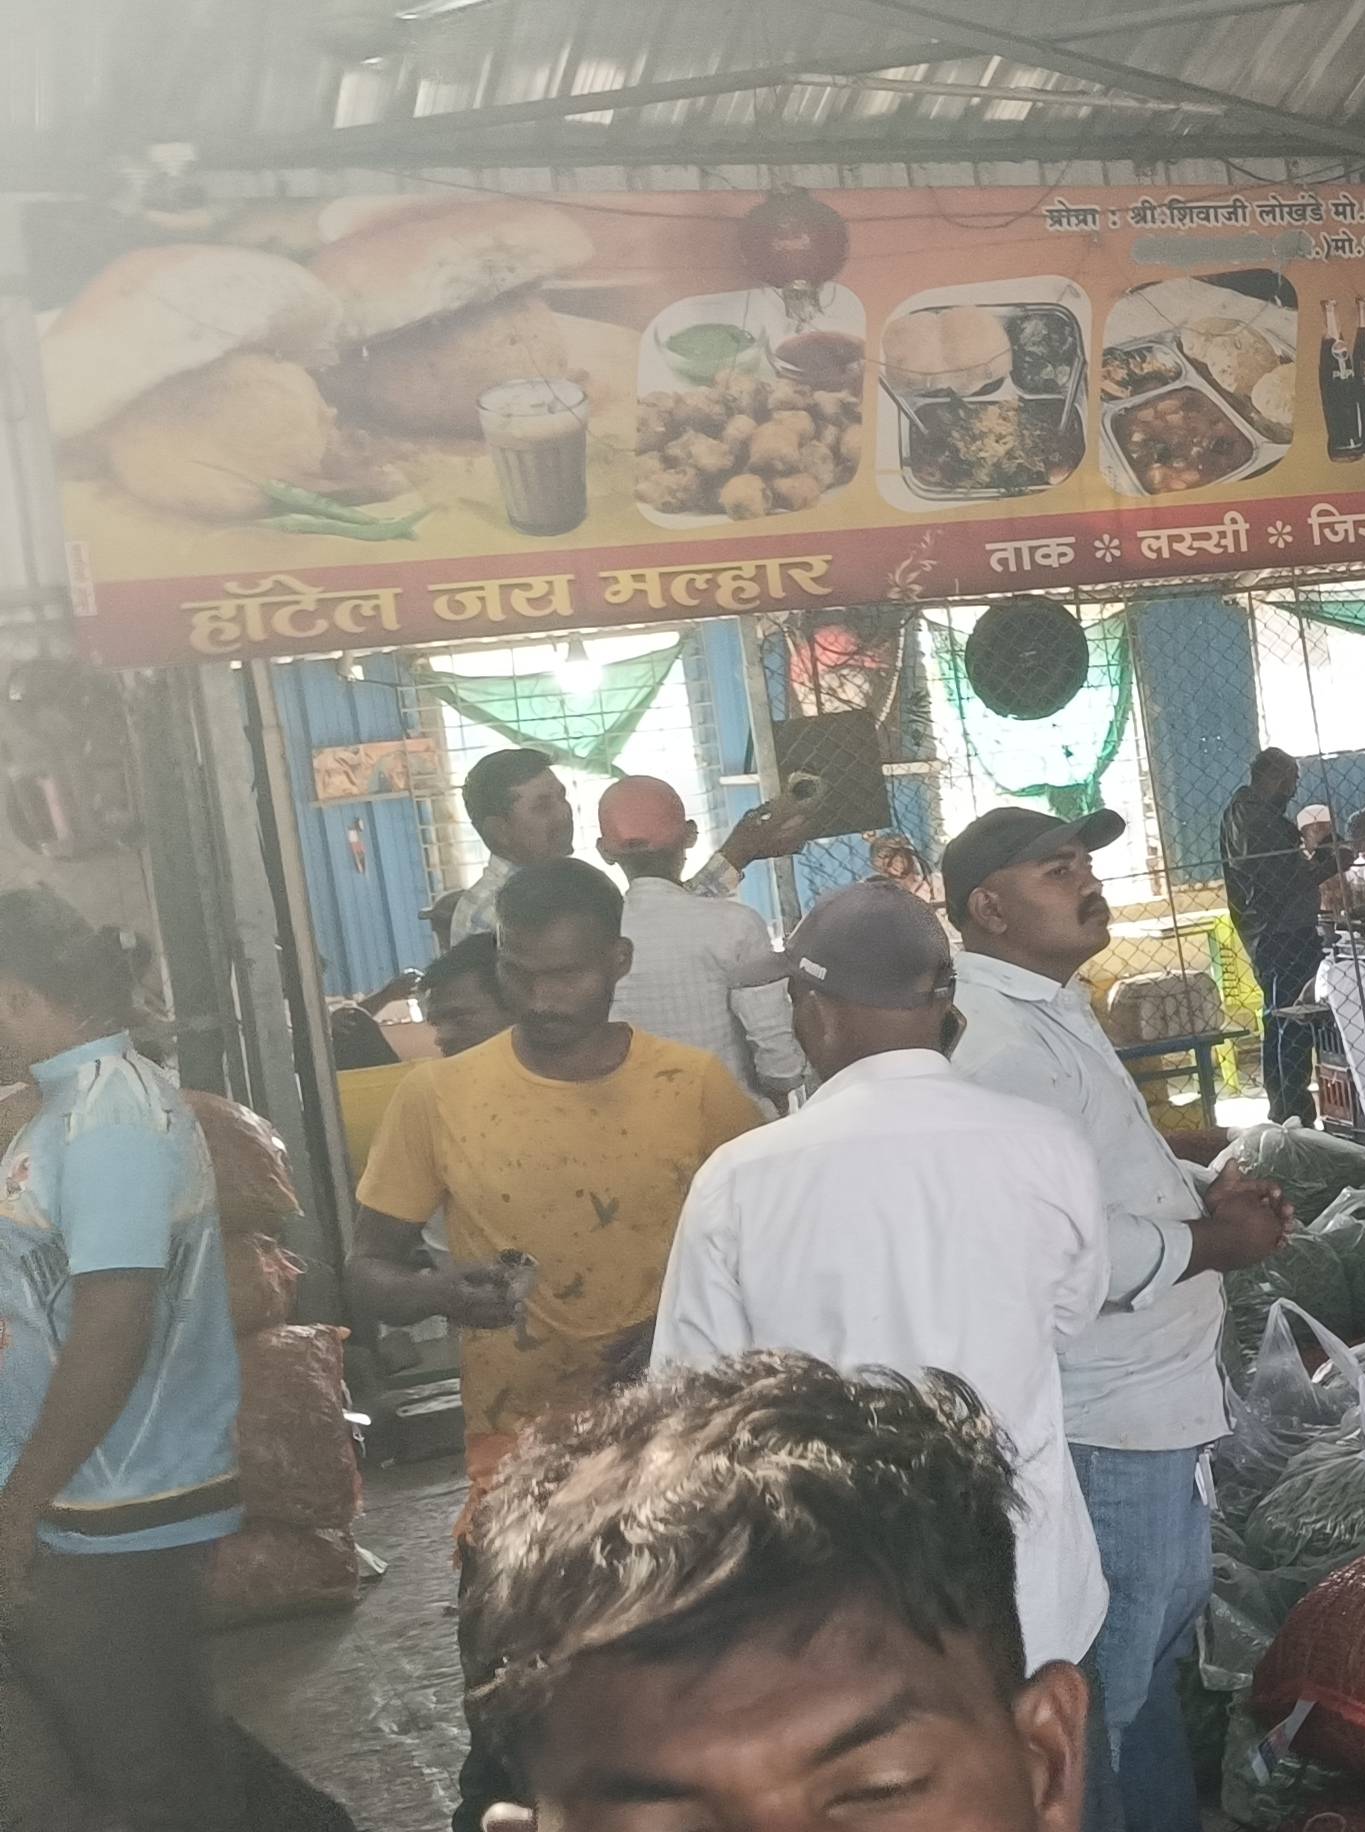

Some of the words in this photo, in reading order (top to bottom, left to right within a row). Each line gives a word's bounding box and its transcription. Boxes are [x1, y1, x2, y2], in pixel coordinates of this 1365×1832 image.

[1046, 199, 1100, 228] प्रोप्रा
[1256, 194, 1324, 223] लोखंडे
[985, 536, 1077, 573] ताक
[1137, 510, 1250, 560] लस्सी
[183, 575, 404, 656] हॉटेल
[428, 574, 579, 625] जय
[599, 554, 833, 611] मल्हार
